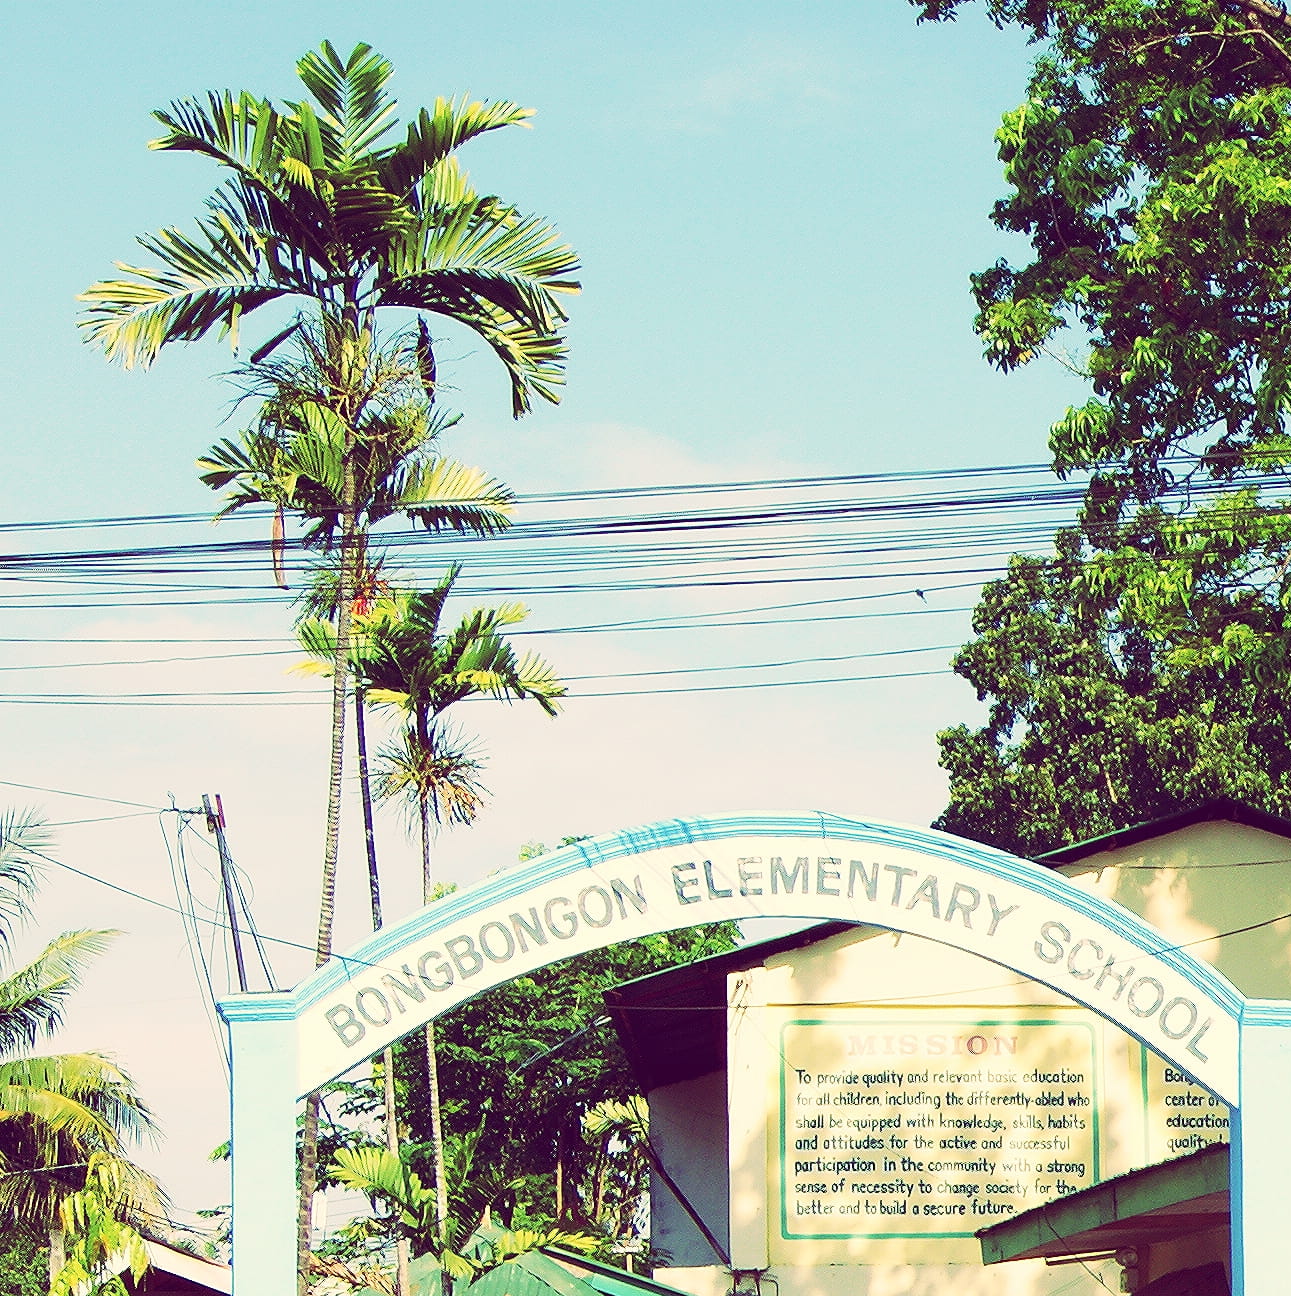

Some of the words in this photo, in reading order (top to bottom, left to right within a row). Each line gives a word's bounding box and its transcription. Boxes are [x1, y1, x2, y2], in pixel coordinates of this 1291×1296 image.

[324, 874, 647, 1048] BONGBONGON
[672, 856, 1020, 937] ELEMENTARY
[1033, 920, 1211, 1064] SCHOOL
[847, 1035, 1018, 1056] MISSION
[795, 1069, 811, 1085] To
[817, 1069, 859, 1085] provide
[862, 1069, 903, 1088] quality
[907, 1068, 928, 1083] and
[933, 1070, 982, 1083] relevant
[988, 1070, 1017, 1083] basic
[1022, 1068, 1084, 1083] education
[797, 1093, 813, 1106] for
[816, 1093, 830, 1106] all
[885, 1092, 940, 1109] including
[946, 1092, 964, 1106] the
[1067, 1092, 1090, 1106] who
[1165, 1090, 1205, 1106] center
[795, 1112, 824, 1129] shall
[829, 1112, 843, 1129] be
[847, 1113, 901, 1132] equipped
[906, 1112, 934, 1129] with
[1048, 1112, 1086, 1130] habits
[1166, 1113, 1230, 1129] education
[795, 1134, 818, 1150] and
[823, 1134, 884, 1150] attitudes
[889, 1134, 908, 1150] for
[915, 1135, 934, 1150] the
[939, 1135, 978, 1150] active
[981, 1135, 1002, 1150] and
[1009, 1135, 1071, 1150] successful
[795, 1156, 876, 1175] participation
[884, 1156, 897, 1172] in
[901, 1156, 924, 1172] the
[928, 1157, 996, 1175] community
[1002, 1158, 1031, 1172] with
[1035, 1161, 1043, 1173] a
[1047, 1158, 1085, 1178] strong
[795, 1181, 828, 1194] sense
[832, 1178, 845, 1193] of
[851, 1178, 914, 1197] necessity
[919, 1179, 933, 1194] to
[937, 1179, 980, 1198] change
[985, 1179, 1029, 1197] society
[1033, 1178, 1051, 1194] for
[1056, 1179, 1077, 1194] the
[797, 1200, 835, 1215] better
[839, 1200, 860, 1215] and
[865, 1201, 877, 1215] to
[880, 1200, 907, 1215] build
[912, 1204, 920, 1216] a
[923, 1203, 966, 1216] secure
